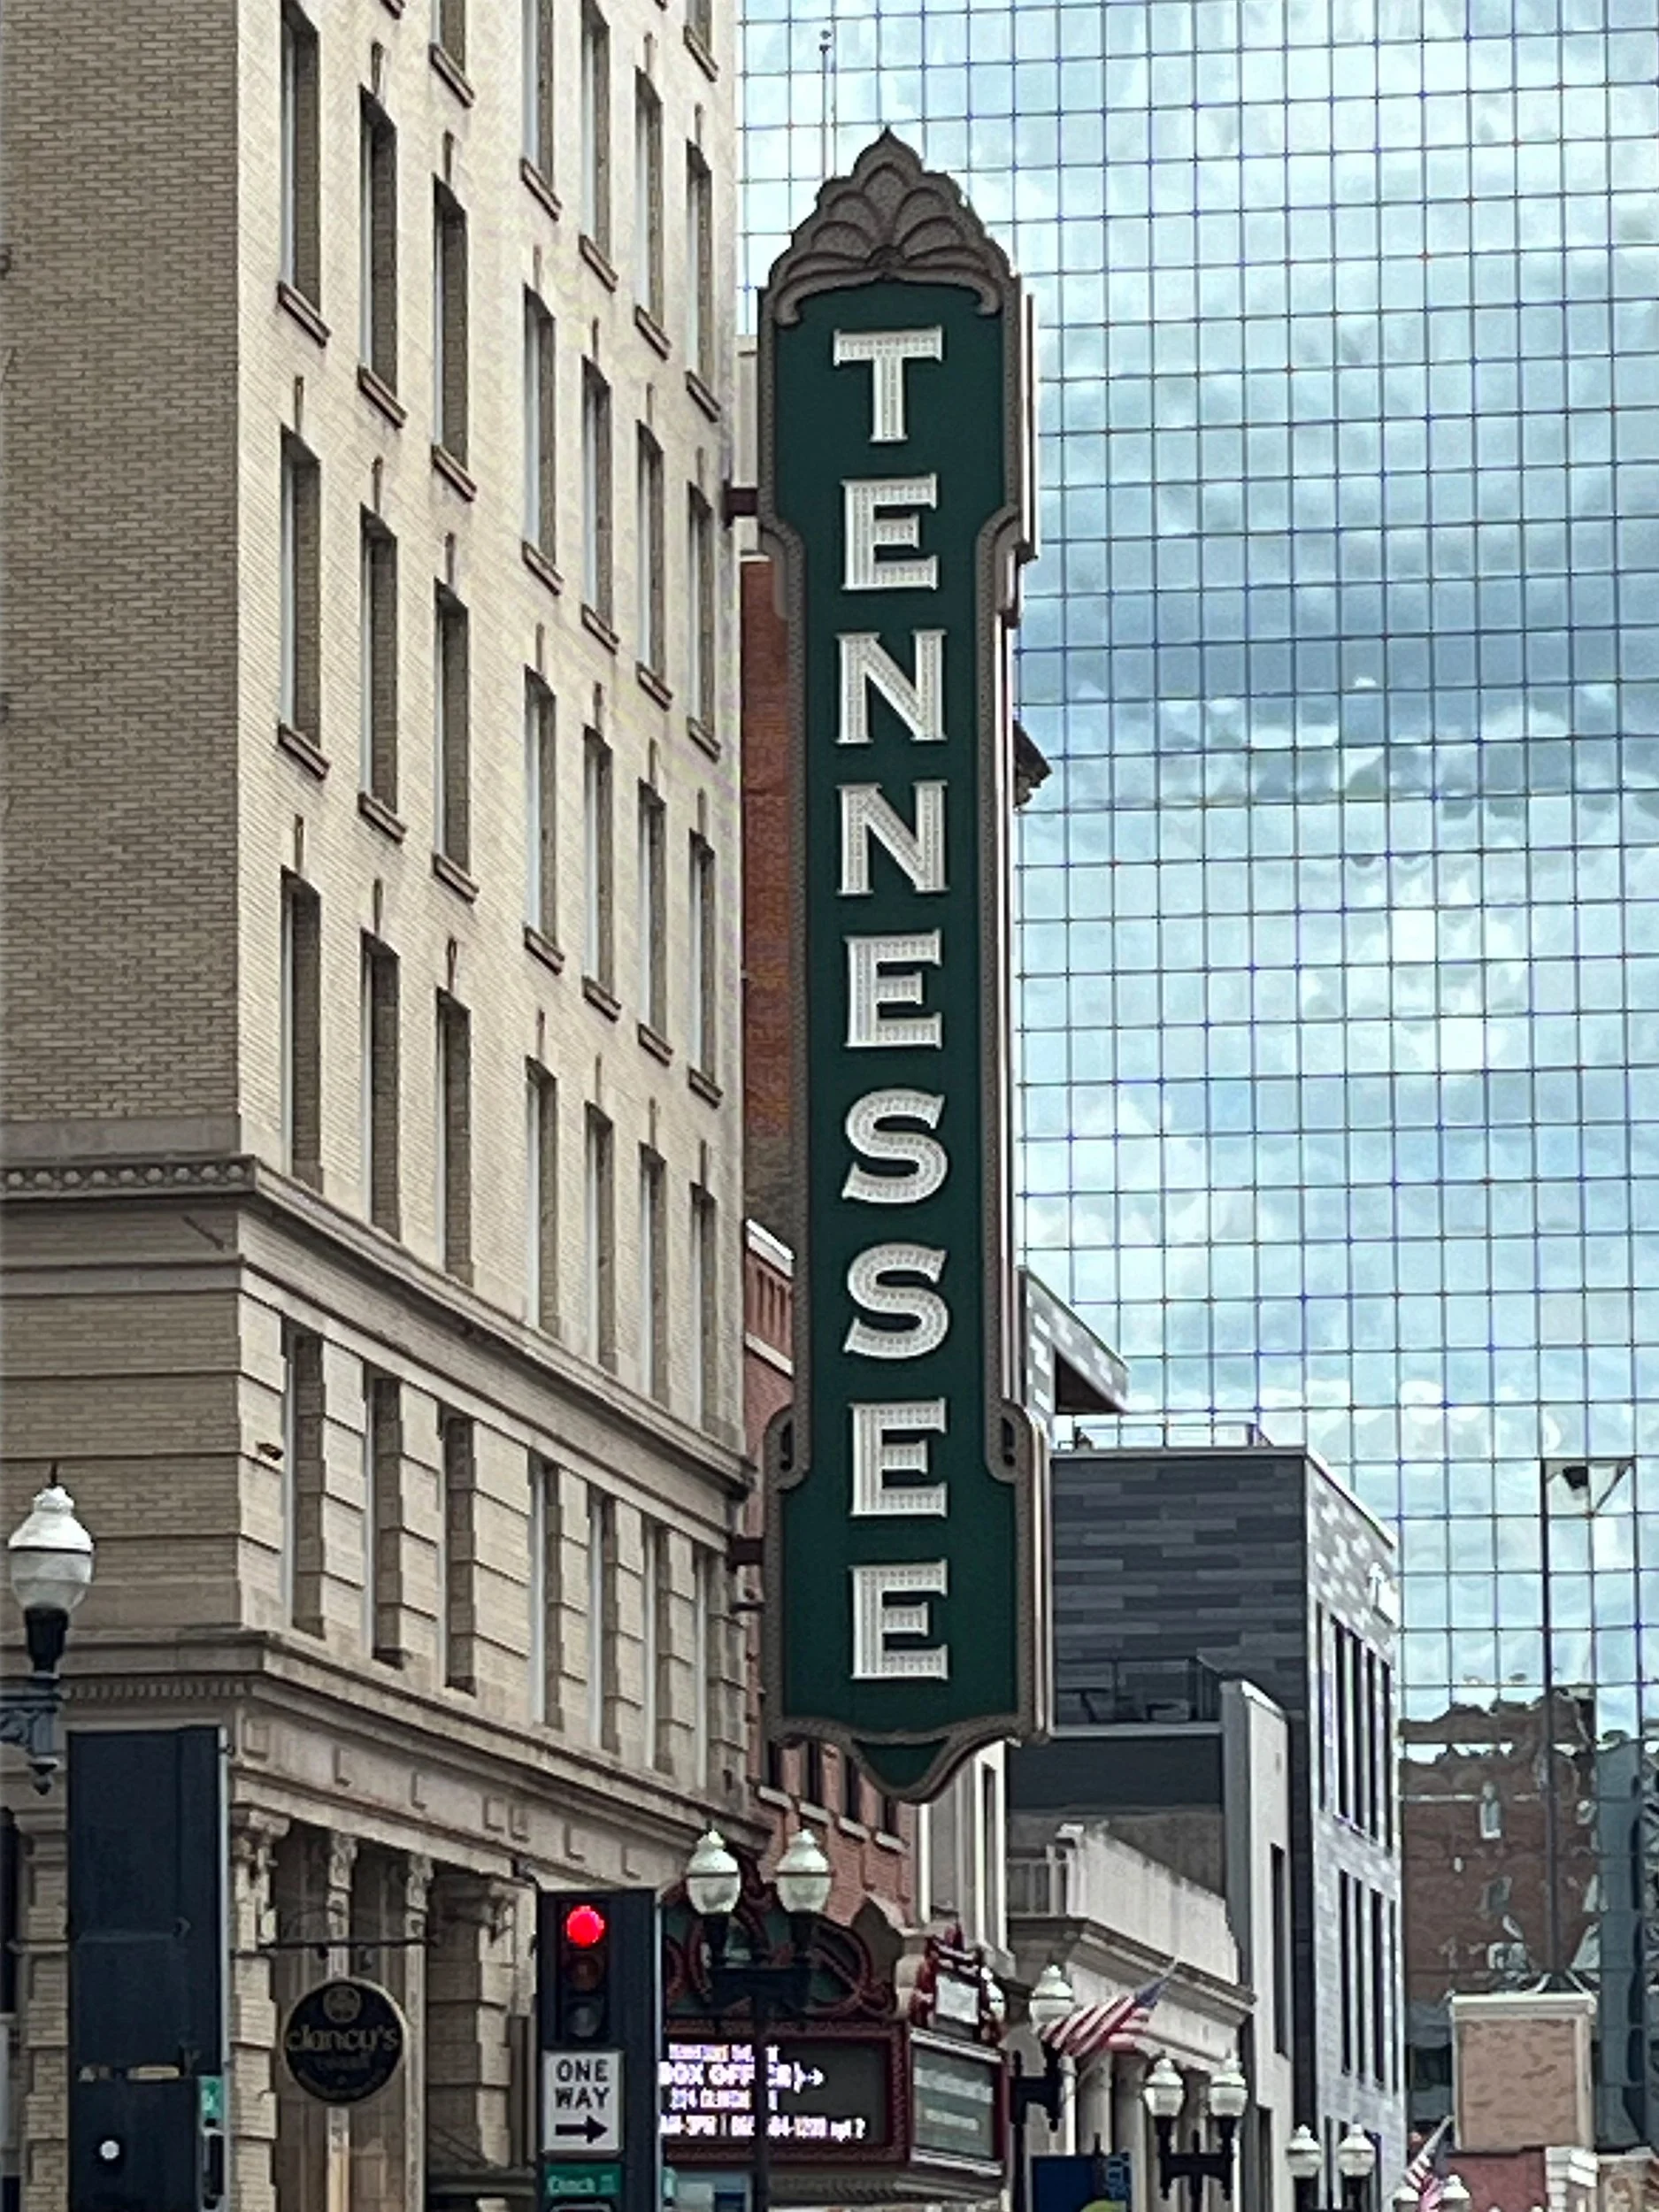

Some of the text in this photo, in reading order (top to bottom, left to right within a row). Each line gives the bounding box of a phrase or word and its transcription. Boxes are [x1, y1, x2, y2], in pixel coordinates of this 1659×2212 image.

[833, 325, 949, 1680] TENNESSEE
[556, 2058, 608, 2082] ONE
[709, 2063, 792, 2087] OFFCE
[555, 2086, 610, 2109] WAY
